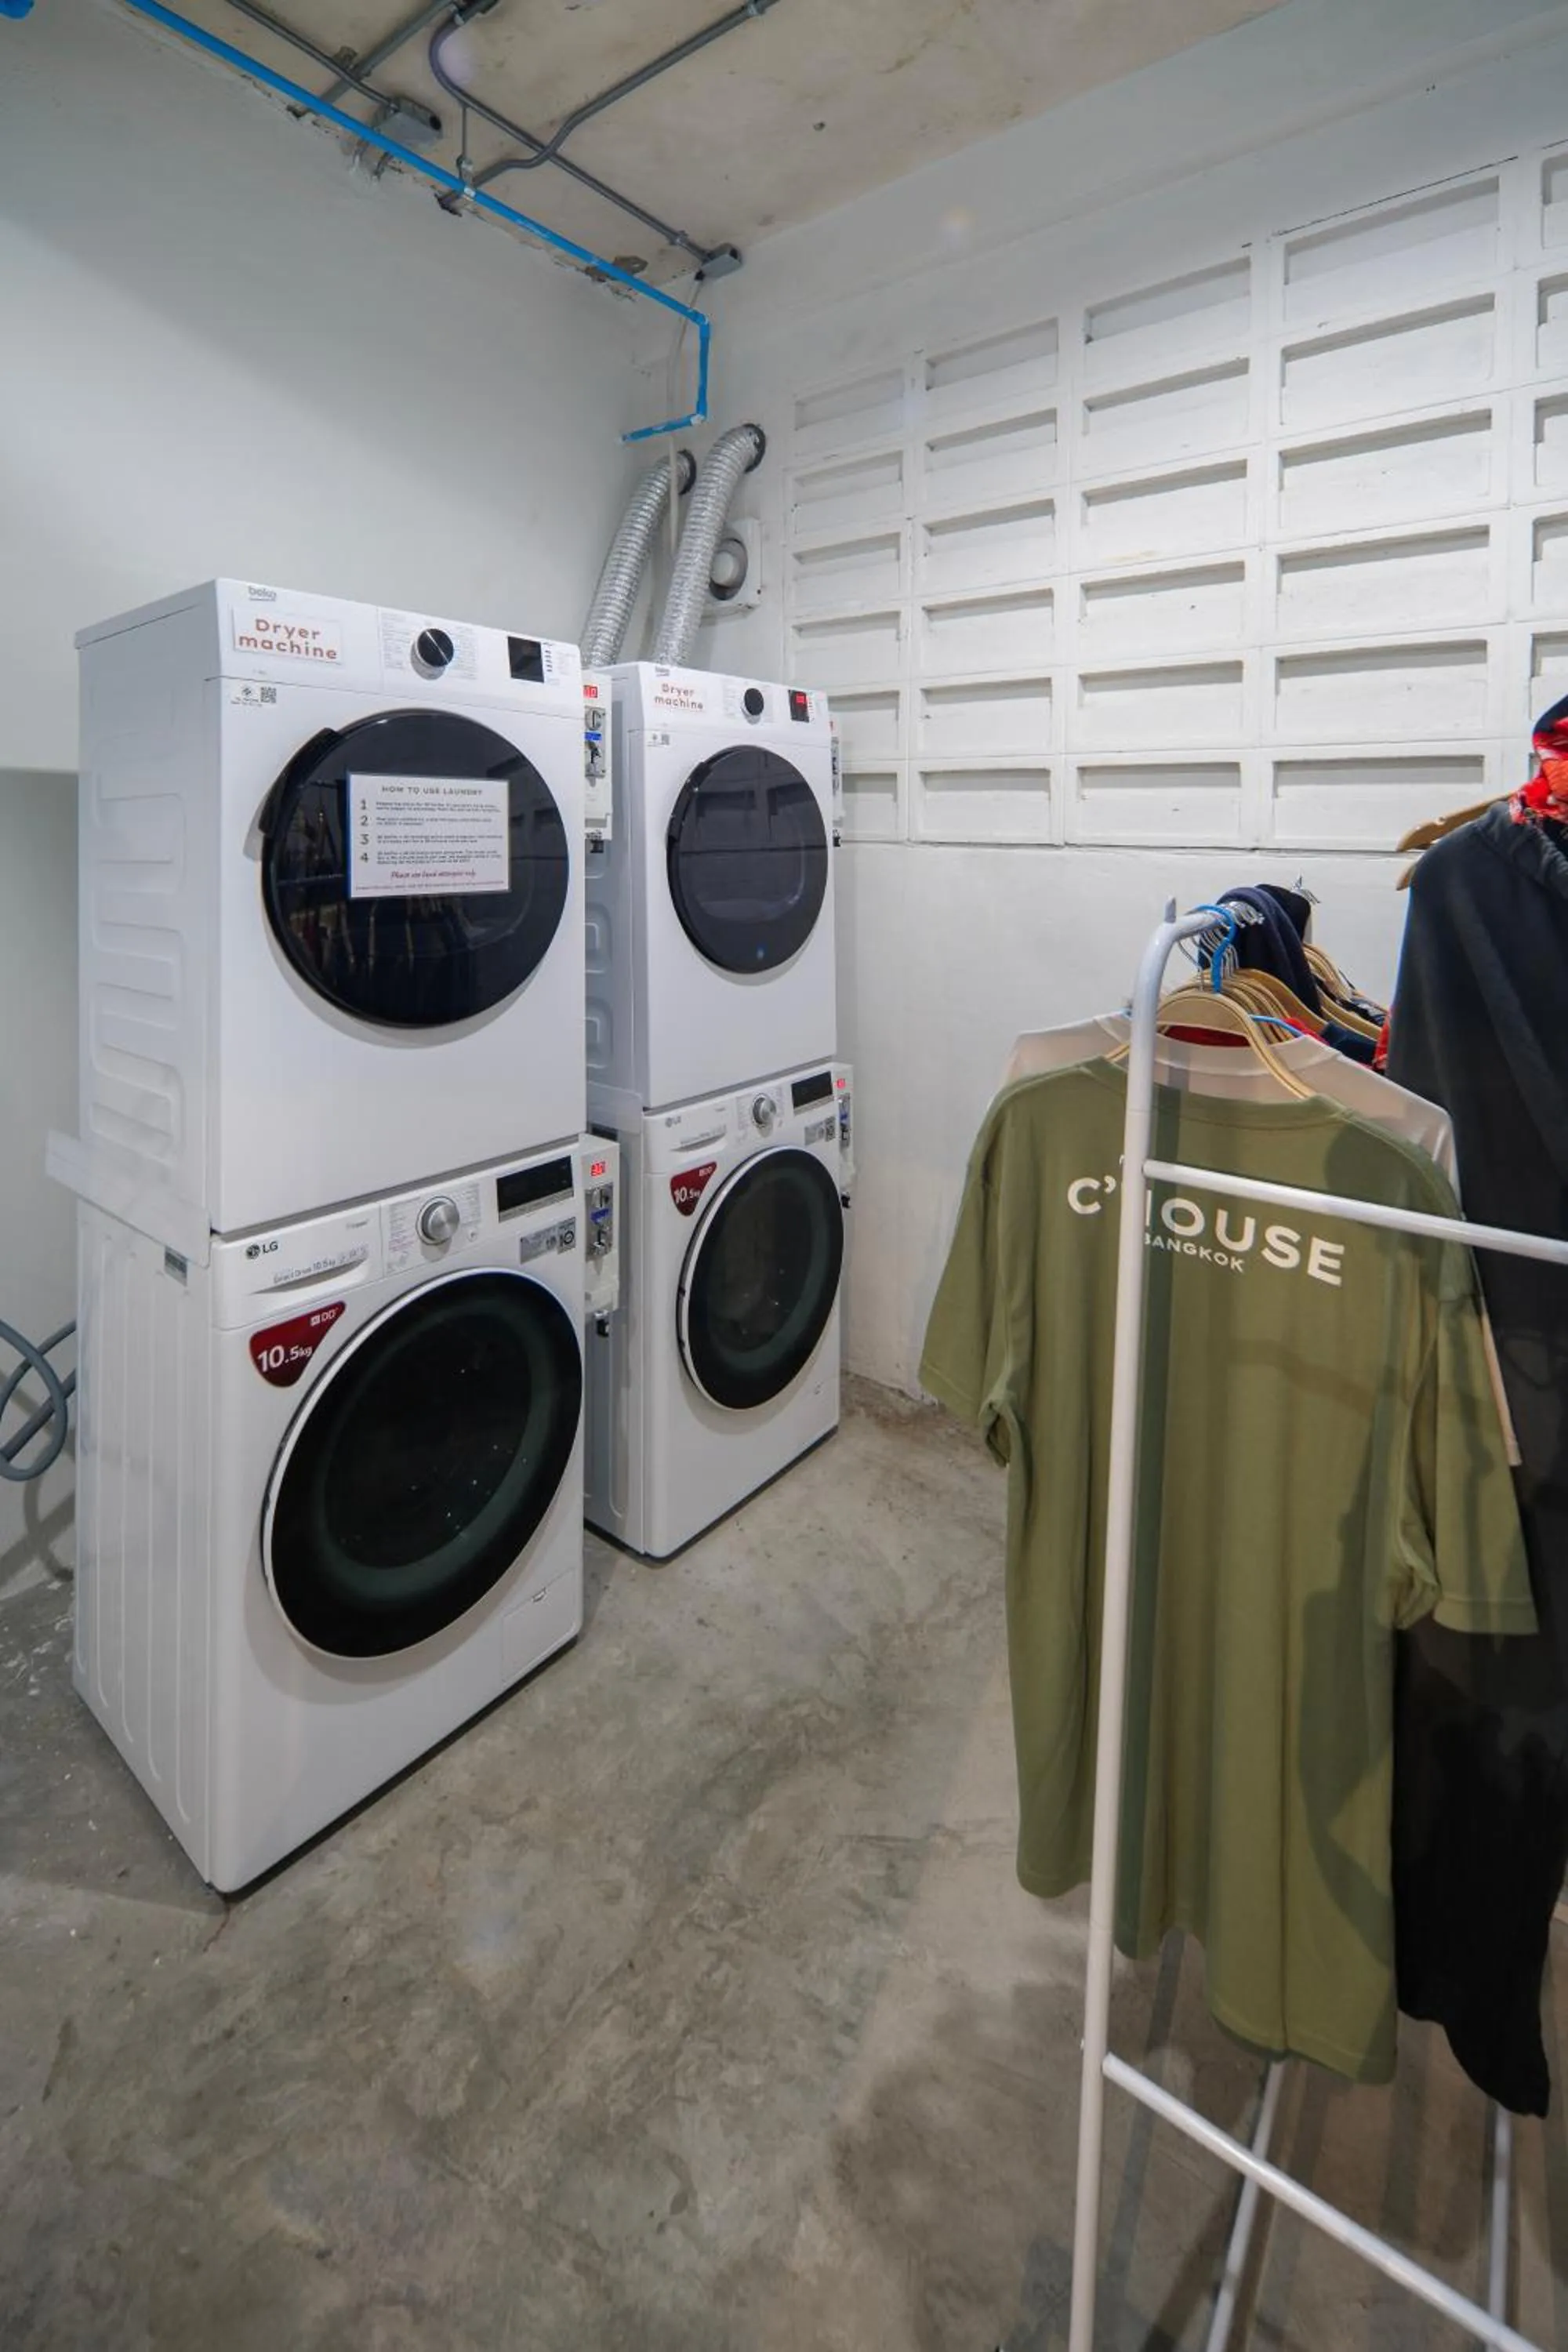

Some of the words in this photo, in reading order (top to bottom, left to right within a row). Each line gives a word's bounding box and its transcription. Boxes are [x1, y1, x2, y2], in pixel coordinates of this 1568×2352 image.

[256, 618, 321, 640] Dryer
[238, 635, 337, 659] machine
[661, 683, 695, 697] Dryer
[654, 695, 703, 710] machine
[443, 787, 483, 796] LAUNDRY
[361, 799, 367, 811] 1
[361, 815, 368, 826] 2
[360, 833, 369, 845] 3
[361, 852, 368, 863] 4
[261, 1240, 279, 1254] LG
[257, 1345, 313, 1373] 10.5kg
